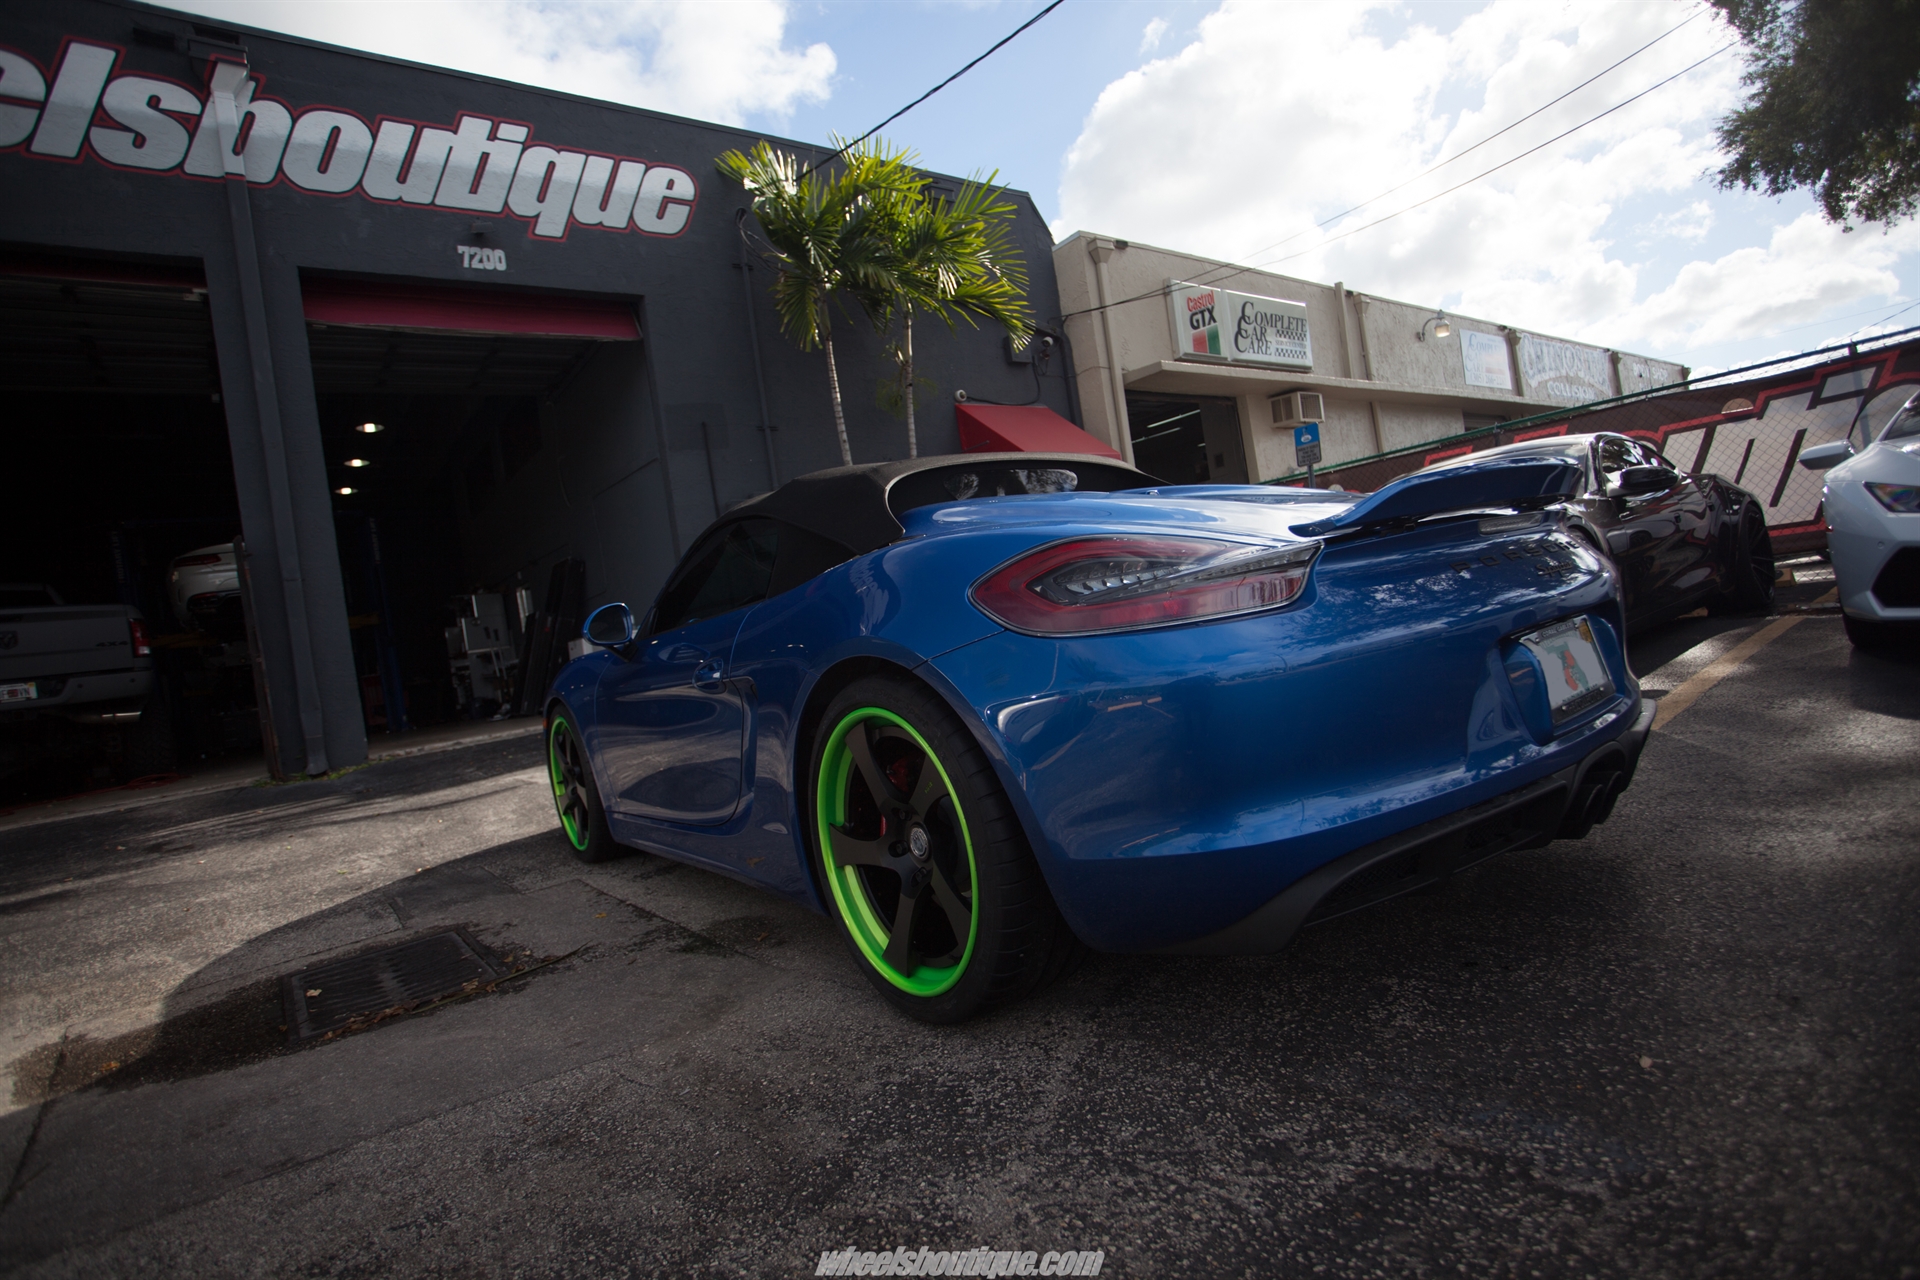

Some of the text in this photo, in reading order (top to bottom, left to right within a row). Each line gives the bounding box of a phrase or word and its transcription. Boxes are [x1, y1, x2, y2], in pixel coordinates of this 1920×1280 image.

[456, 245, 506, 271] 7200
[1187, 290, 1215, 312] Castrol
[1189, 306, 1217, 330] GTX
[1237, 315, 1269, 342] CAR
[1241, 301, 1307, 333] COMPLETE
[1234, 328, 1272, 357] CARE
[1547, 381, 1598, 400] COLLISION
[1450, 541, 1578, 573] PORSCHE
